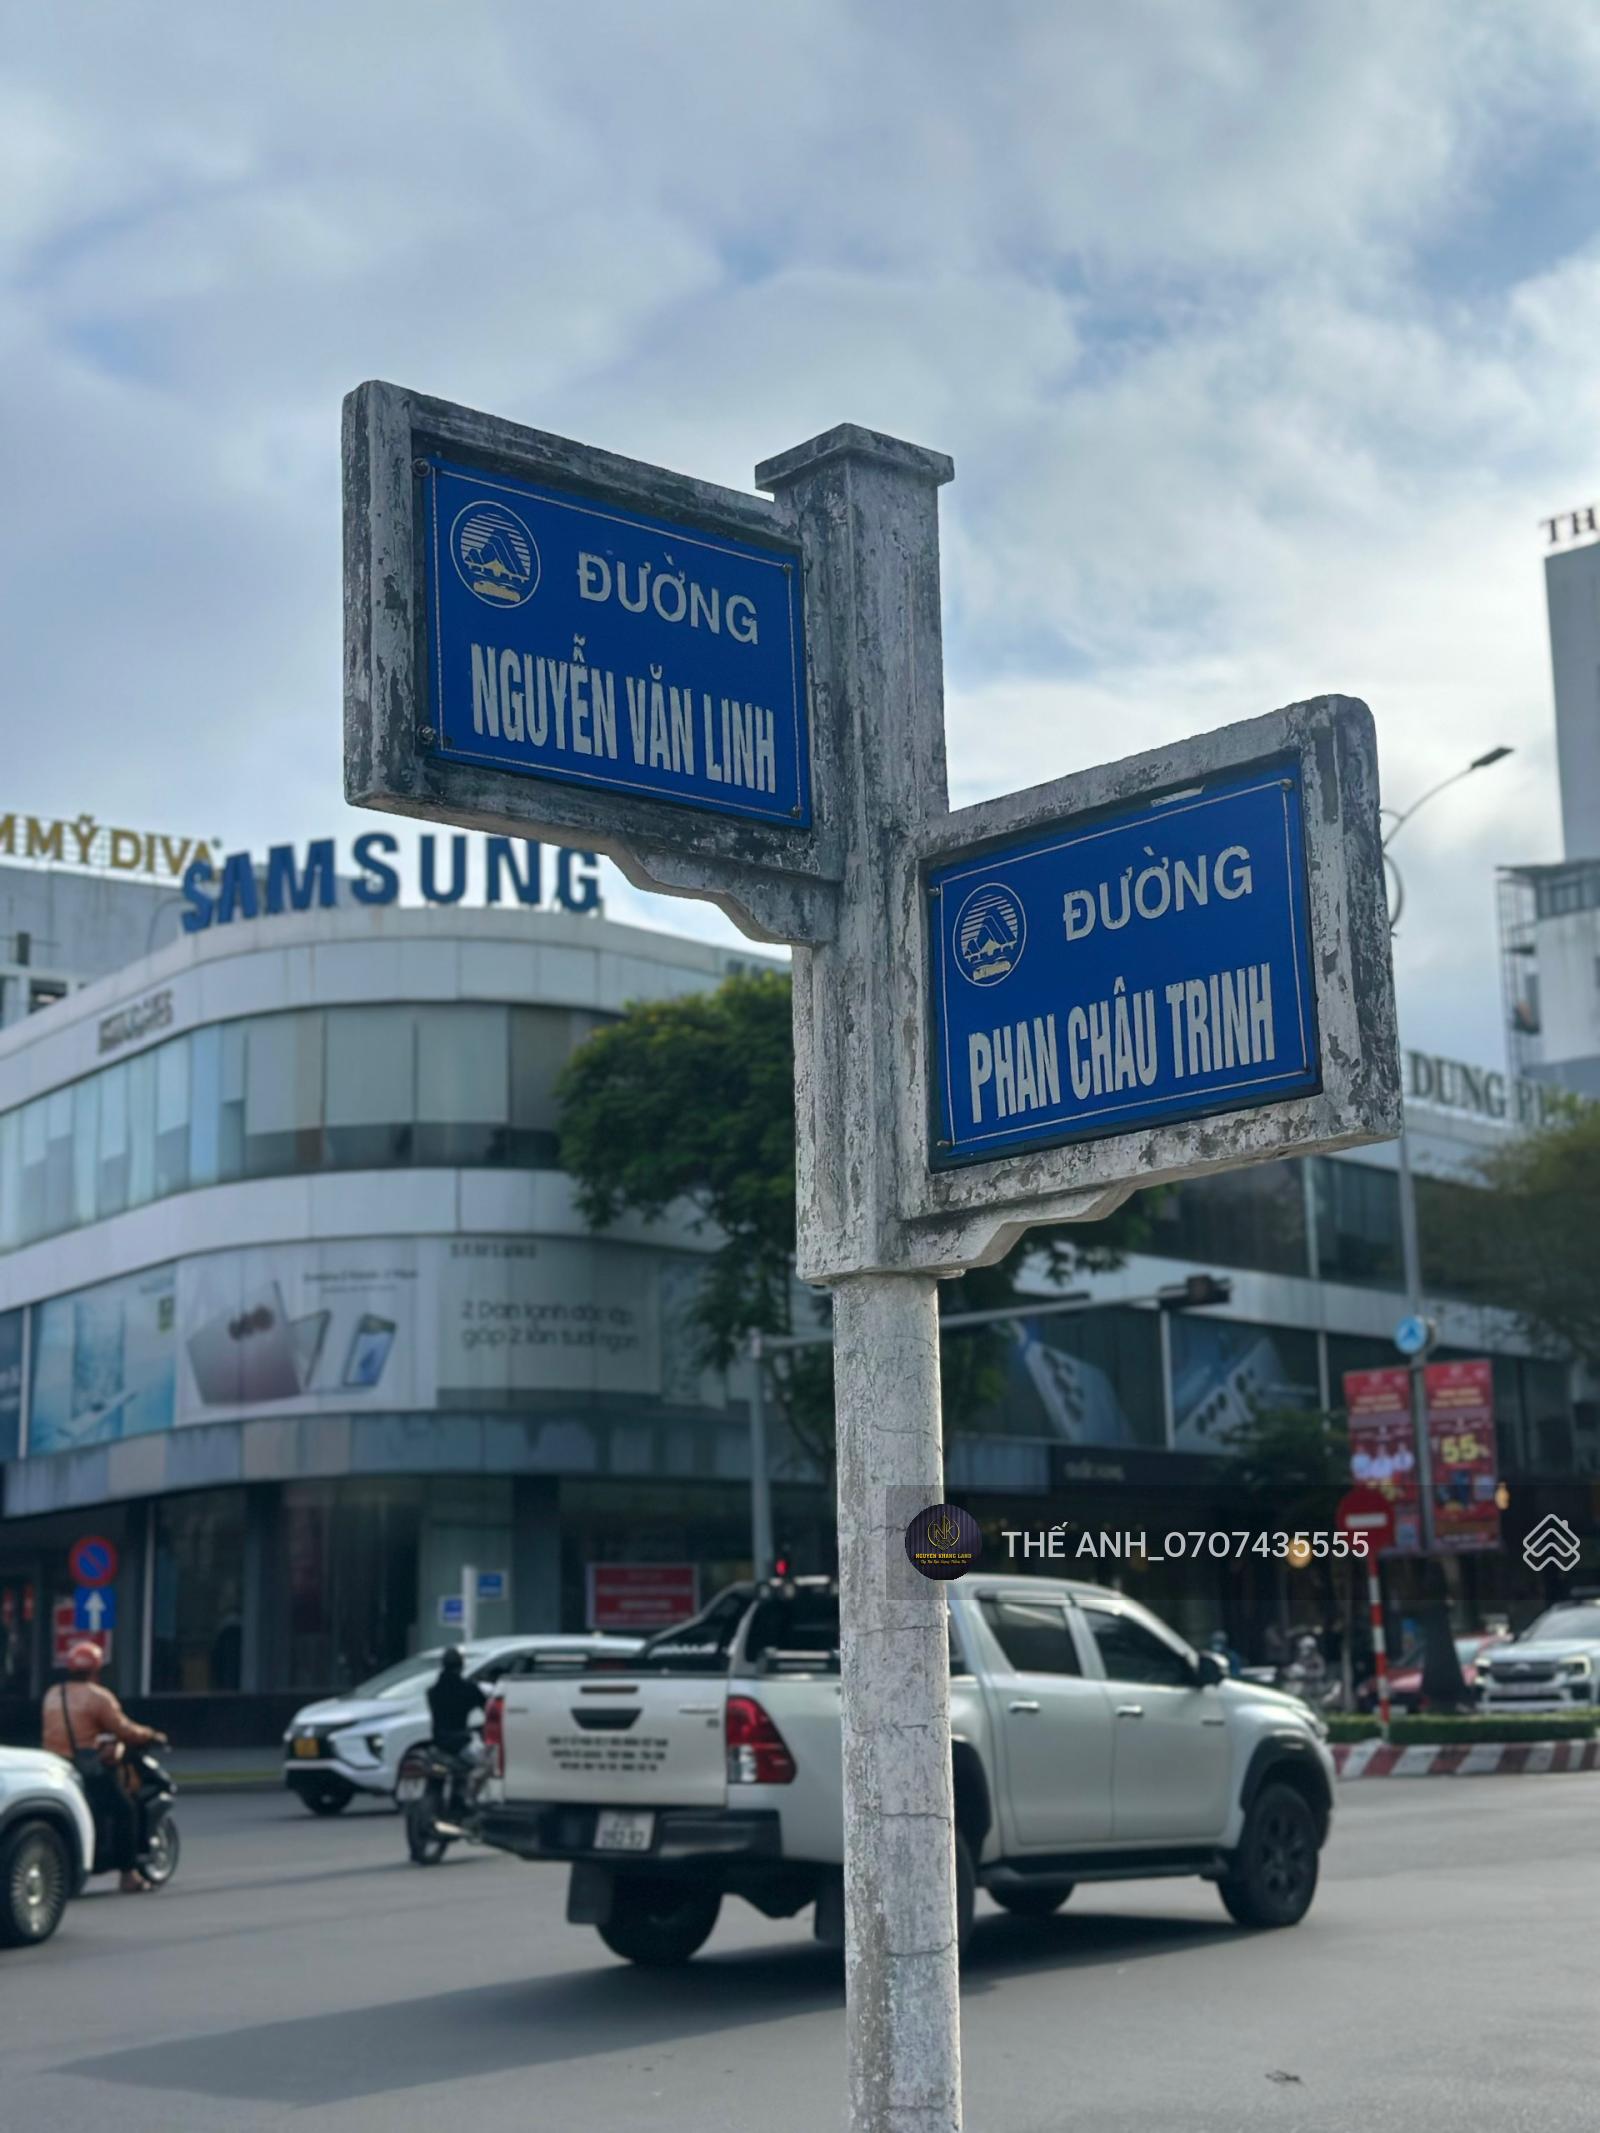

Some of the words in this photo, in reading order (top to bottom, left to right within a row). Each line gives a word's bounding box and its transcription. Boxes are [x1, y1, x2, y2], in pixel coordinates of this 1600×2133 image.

[576, 550, 759, 645] ĐƯỜNG
[470, 632, 618, 760] NGUYỄN
[625, 663, 694, 776] VĂN
[703, 693, 776, 793] LINH
[181, 831, 604, 934] SAMSUNG
[1062, 845, 1254, 941] ĐƯỜNG
[968, 1014, 1061, 1124] PHAN
[1067, 976, 1158, 1100] CHÂU
[1165, 962, 1276, 1079] TRINH
